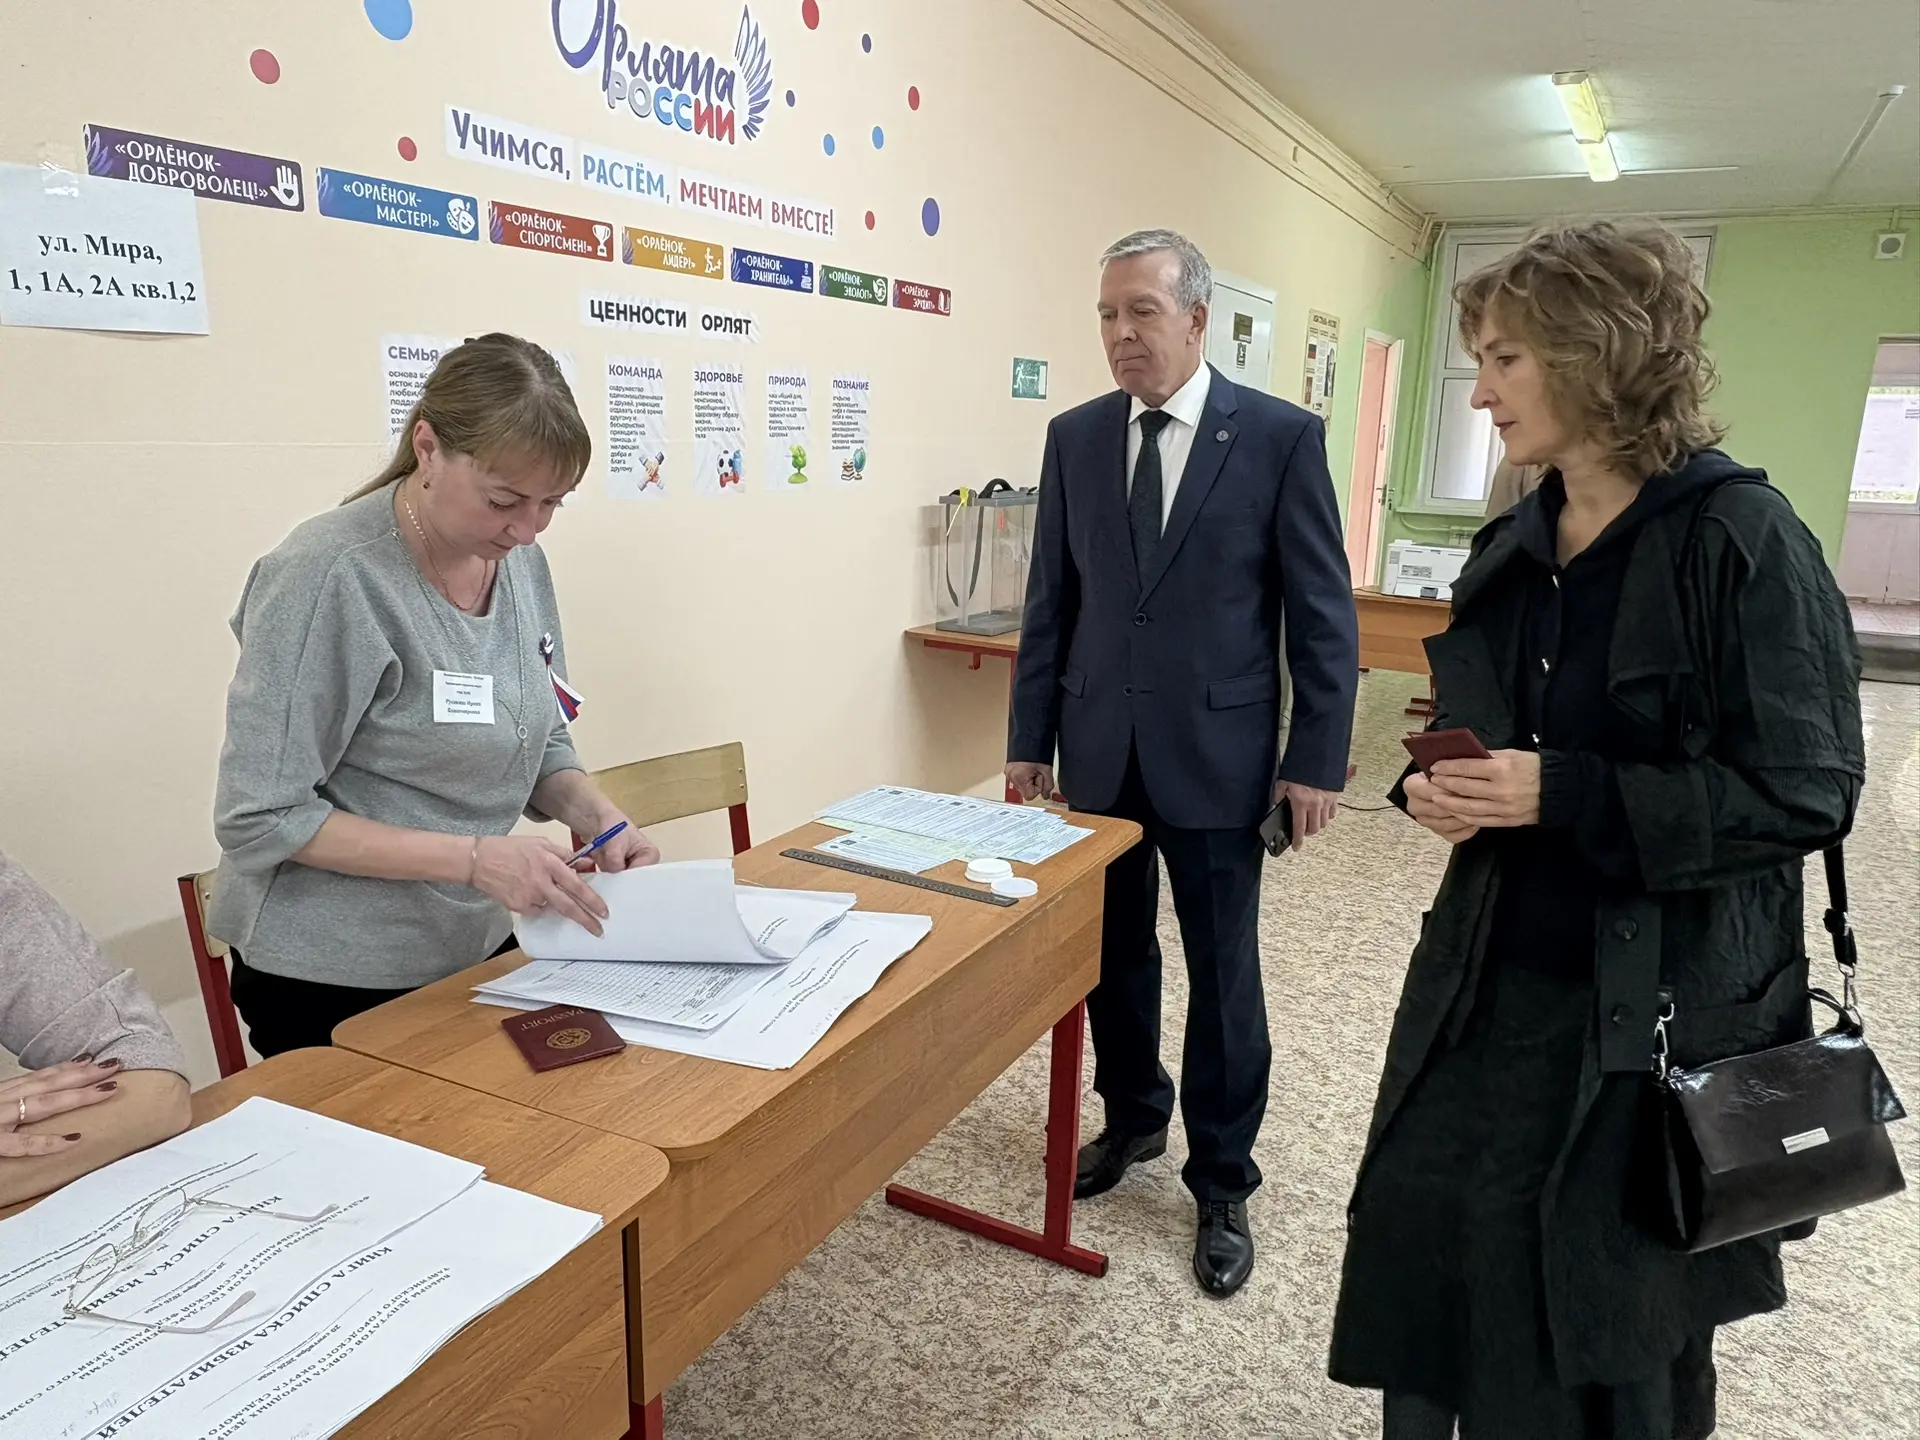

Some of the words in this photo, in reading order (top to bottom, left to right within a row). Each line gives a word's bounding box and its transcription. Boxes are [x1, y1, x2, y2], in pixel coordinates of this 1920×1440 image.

[607, 70, 735, 145] РОССИИ
[583, 153, 671, 204] РАСТЁМ,
[680, 178, 763, 220] МЕЧТАЕМ
[771, 201, 834, 236] ВМЕСТЕ!
[376, 206, 440, 229] МАСТЕР!»
[38, 235, 77, 256] ул.
[83, 233, 162, 264] Мира,
[8, 269, 32, 295] 1,
[39, 271, 84, 298] 1А,
[89, 274, 125, 297] 2А
[131, 281, 196, 304] кв.1,2
[590, 299, 687, 328] ЦЕННОСТИ
[701, 314, 752, 335] ОРЛЯТ
[388, 346, 439, 361] СЕМЬЯ
[609, 364, 663, 380] КОМАНДА
[694, 371, 743, 383] ЗДОРОВЬЕ
[768, 376, 806, 387] ПРИРОДА
[832, 380, 869, 390] ПОЗНАНИЕ
[521, 1008, 584, 1031] PASSPORT
[144, 1226, 220, 1276] СПИСКА
[331, 1247, 392, 1278] КНИГА
[227, 1247, 282, 1292] ДЕПУТАТОВ
[411, 1274, 451, 1298] ВЫБОРЫ
[383, 1268, 450, 1309] ТАЙГИНСКОГО
[253, 1282, 331, 1337] СПИСКА
[355, 1298, 410, 1346] ДЕПУТАТОВ
[110, 1313, 179, 1351] ФЕДРАЦИИ
[317, 1311, 382, 1363] ГОРОДСКОГО
[78, 1356, 115, 1380] ДУМЫ
[272, 1365, 316, 1391] ОКРУГА
[312, 1348, 354, 1376] СОВЕТА
[95, 1340, 255, 1440] ИЗБИРАТЕЛЕЙ
[249, 1377, 312, 1418] НАРОДНЫХ
[208, 1393, 271, 1435] СЕДЬМОГО
